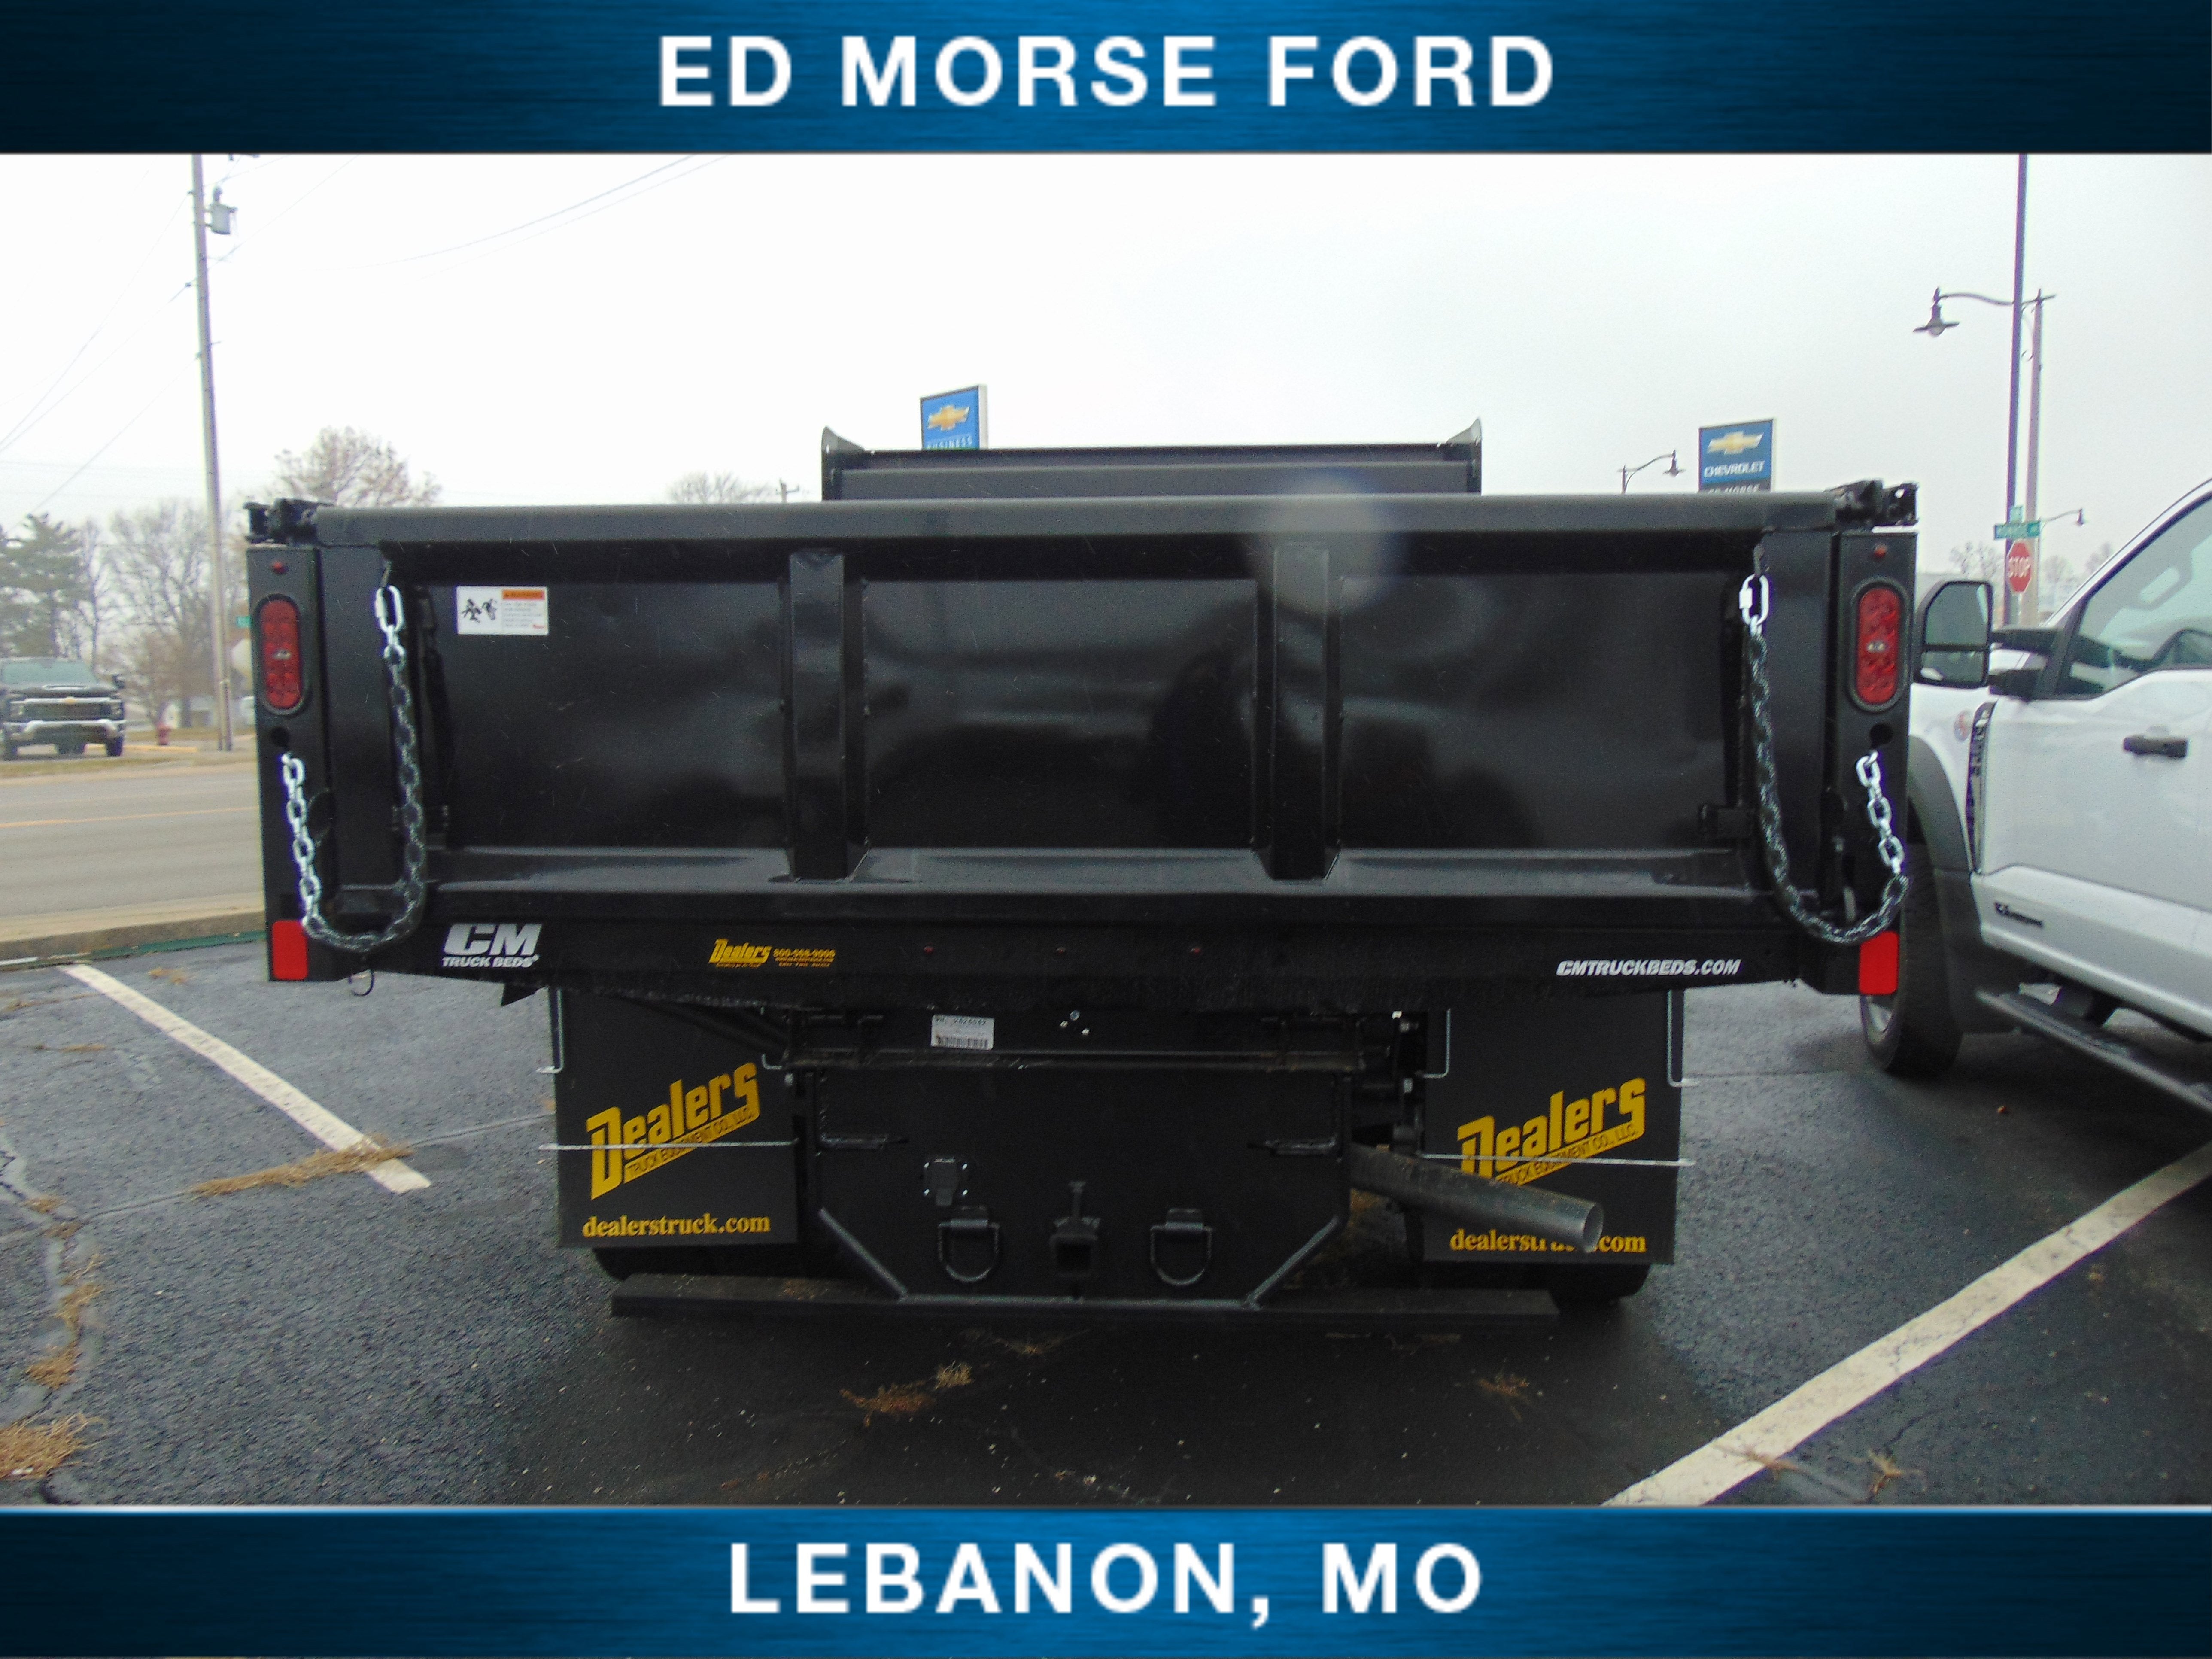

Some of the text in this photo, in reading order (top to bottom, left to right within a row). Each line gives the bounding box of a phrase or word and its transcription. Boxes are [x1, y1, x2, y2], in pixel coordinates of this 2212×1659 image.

[1704, 460, 1765, 477] CHEVROLET
[2008, 556, 2031, 577] STOP
[444, 924, 542, 956] CM
[709, 938, 772, 963] Dealers
[442, 957, 491, 967] TRUCK
[1556, 959, 1741, 976] CMTRUCKBEDS.COM
[586, 1063, 760, 1200] Dealers
[582, 1213, 770, 1237] dealerstruck.com
